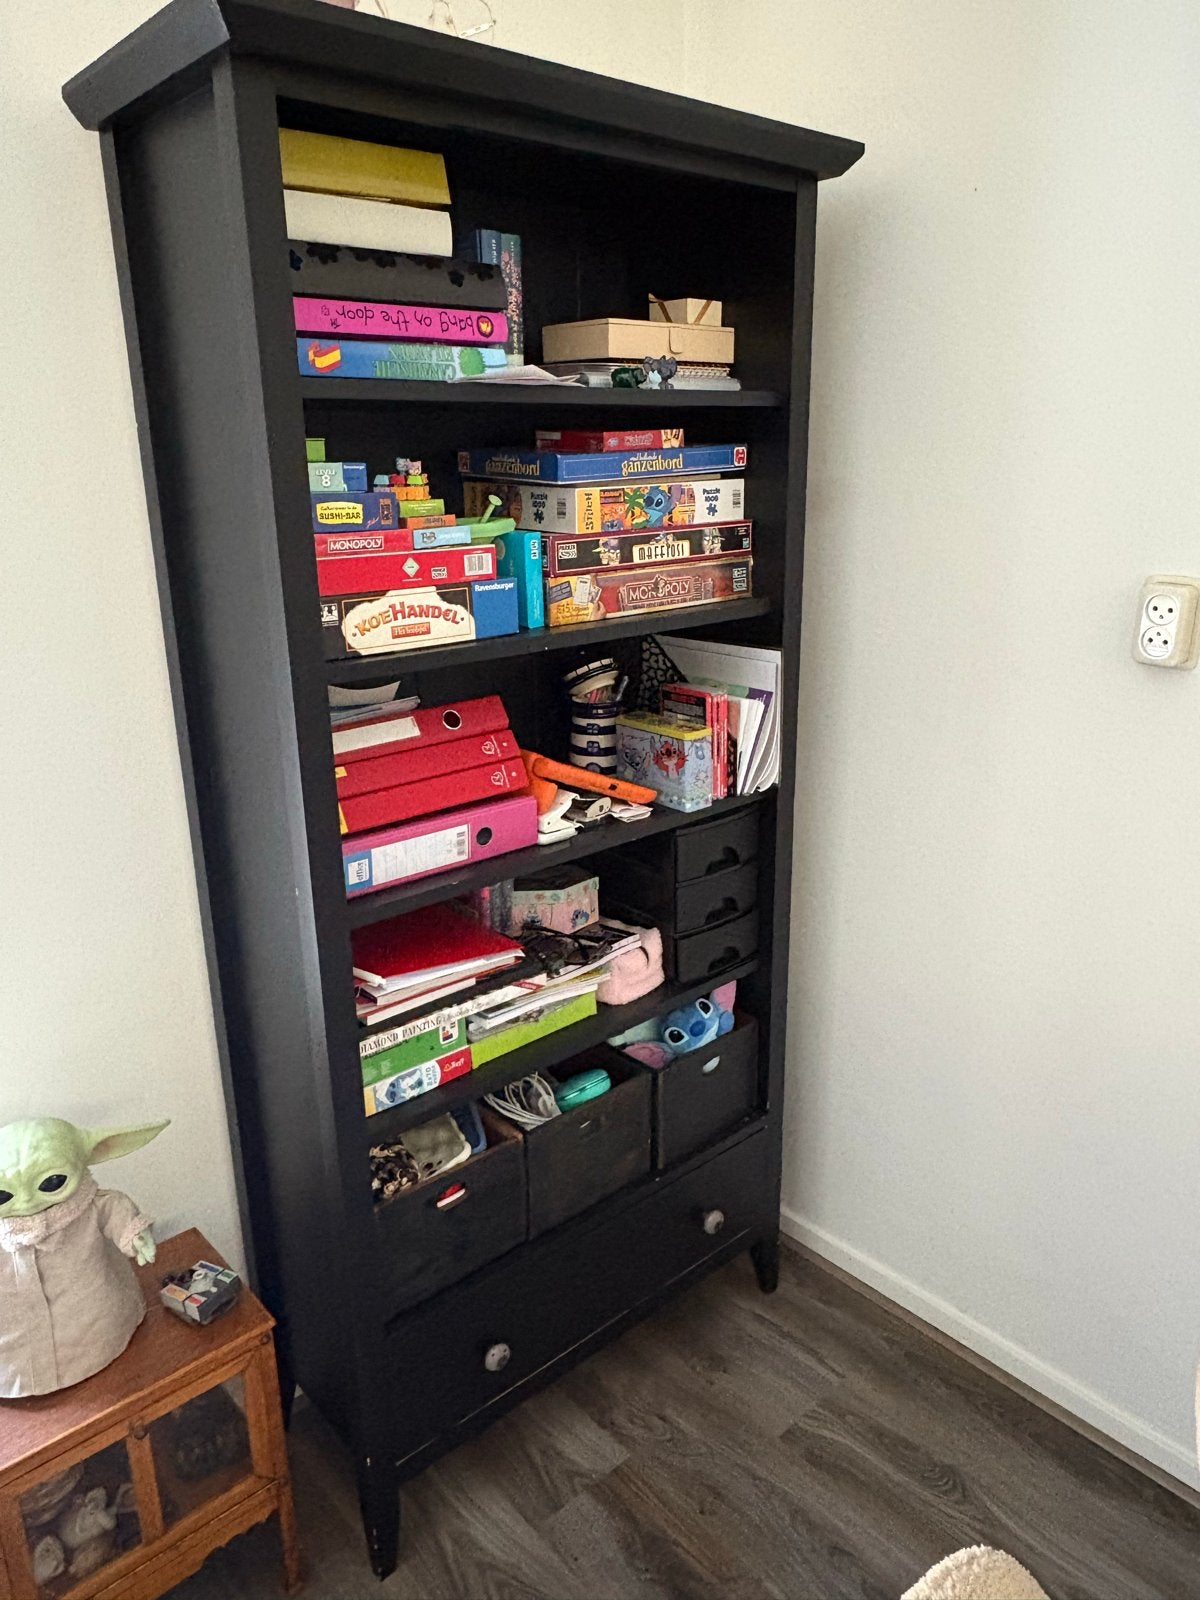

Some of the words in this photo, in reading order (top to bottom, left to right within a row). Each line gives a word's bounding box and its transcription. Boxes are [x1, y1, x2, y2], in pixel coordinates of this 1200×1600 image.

[335, 305, 375, 326] door
[380, 310, 409, 332] the
[414, 310, 433, 328] on
[439, 312, 475, 336] bang
[621, 453, 683, 476] ganzenbord
[321, 474, 331, 487] 8
[702, 487, 720, 496] Puzzle
[704, 495, 718, 503] 1000
[319, 512, 361, 520] SUSHI-BAR
[330, 537, 382, 551] MONOPOLY
[474, 582, 514, 592] Ravensburger
